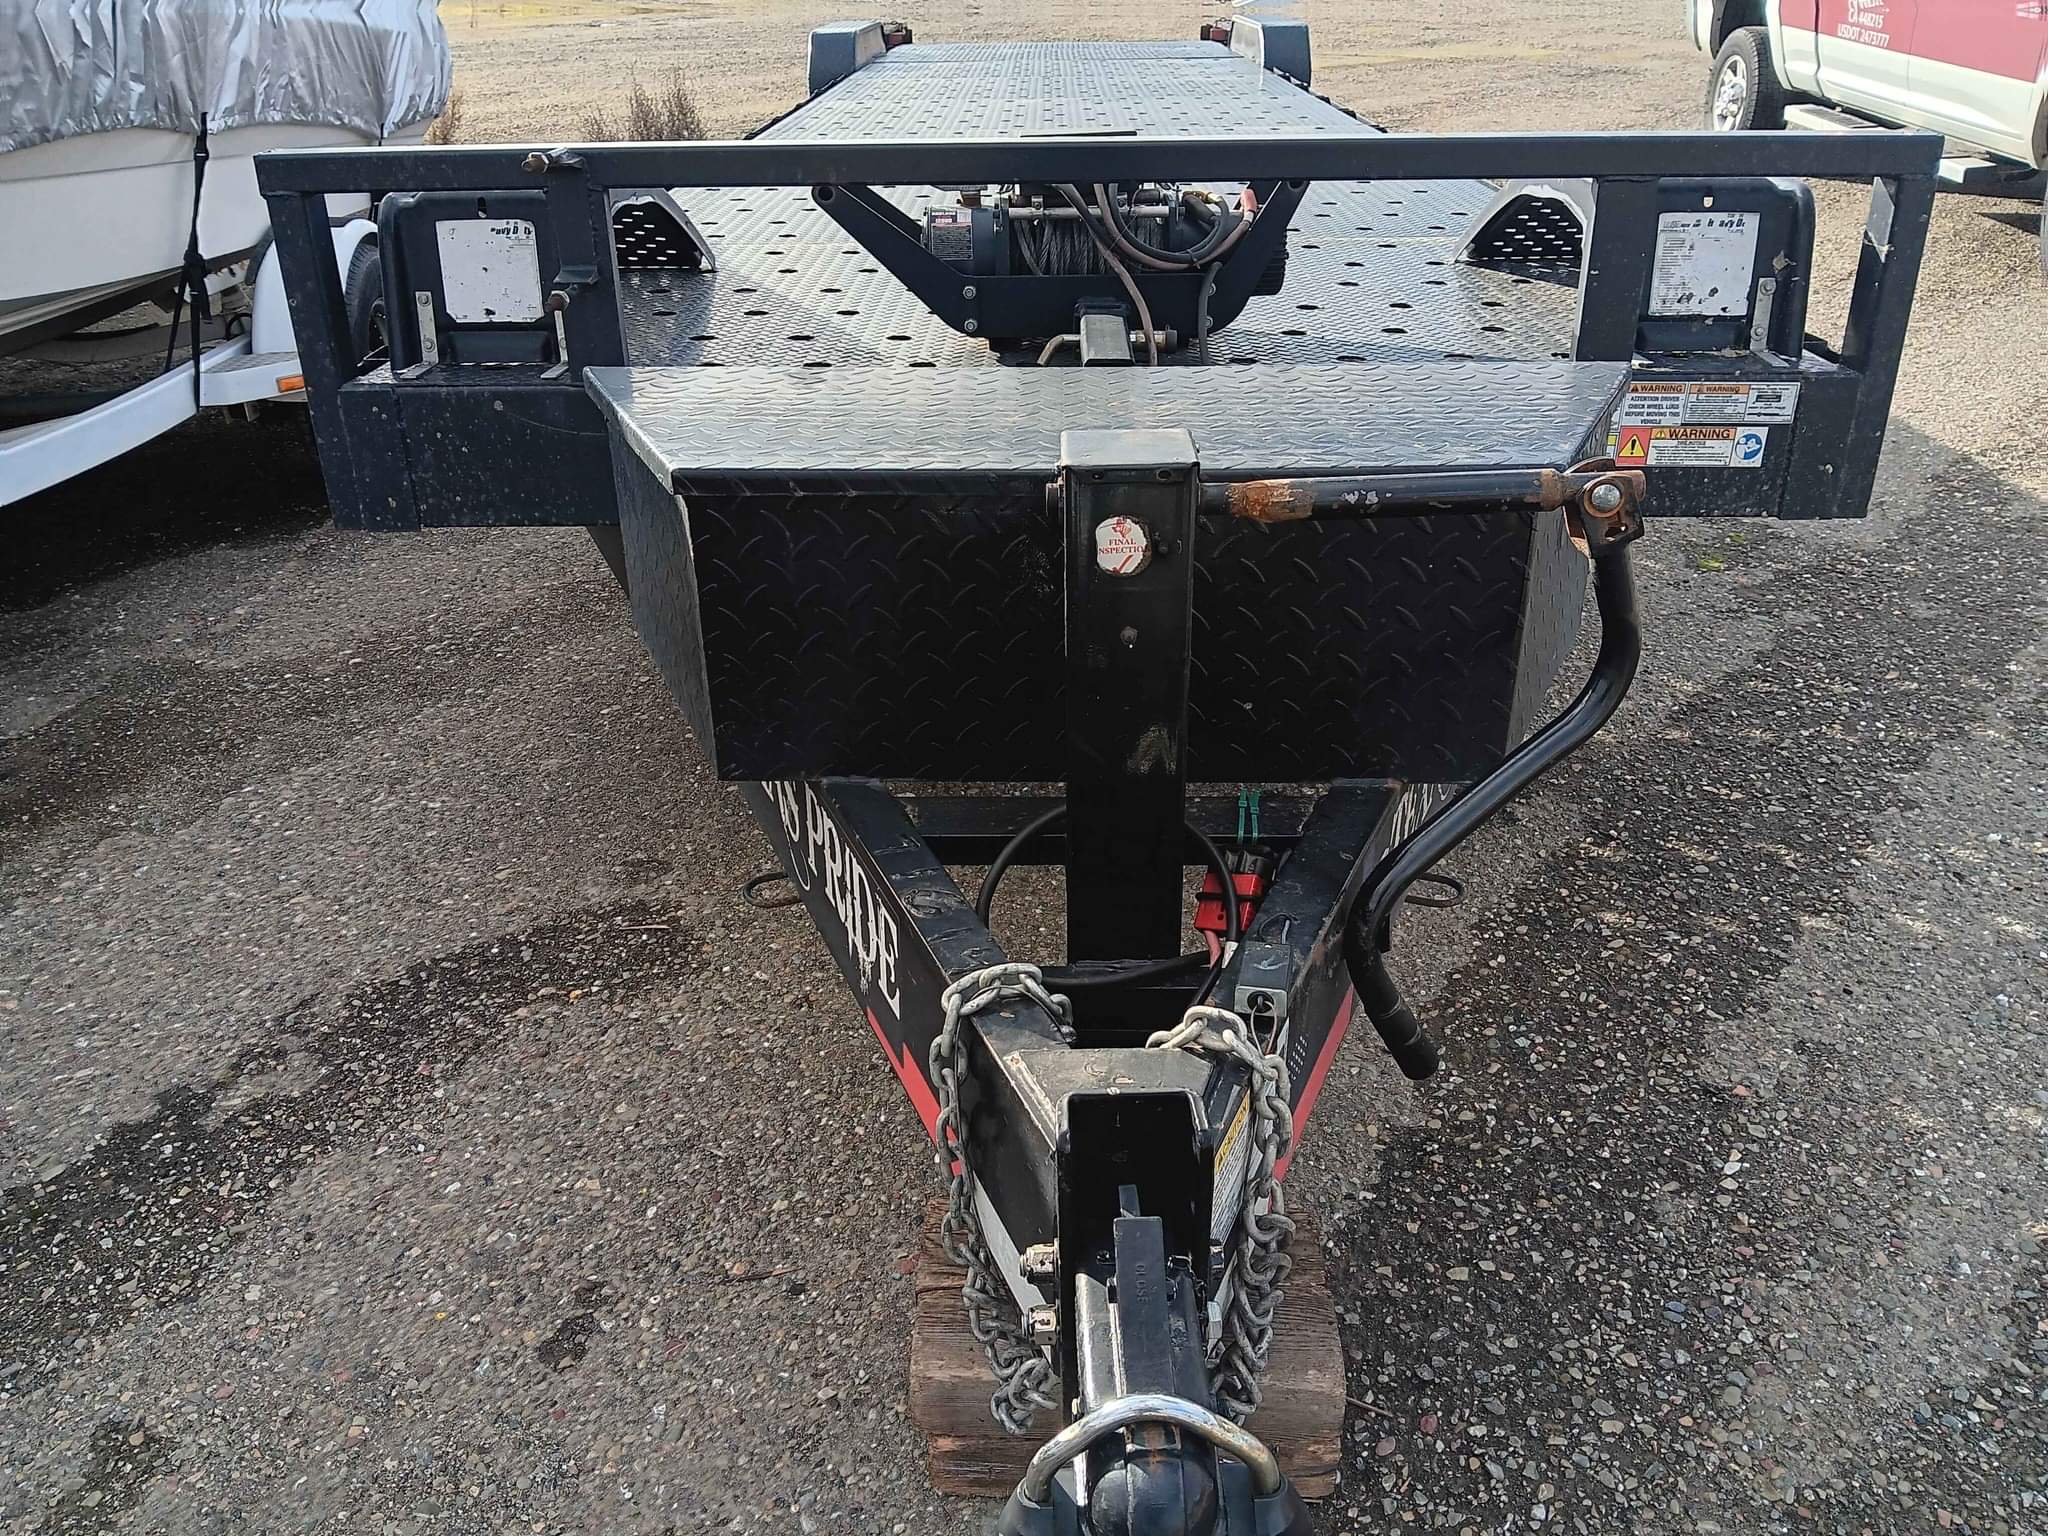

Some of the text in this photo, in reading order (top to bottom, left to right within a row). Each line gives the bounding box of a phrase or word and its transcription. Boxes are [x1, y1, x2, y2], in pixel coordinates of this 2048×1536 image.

[1838, 23, 1860, 41] USDOT
[1640, 385, 1683, 393] WARNING
[1668, 429, 1731, 439] WARNING
[1098, 545, 1146, 554] NSPECTIO
[804, 781, 900, 1021] PRIDE
